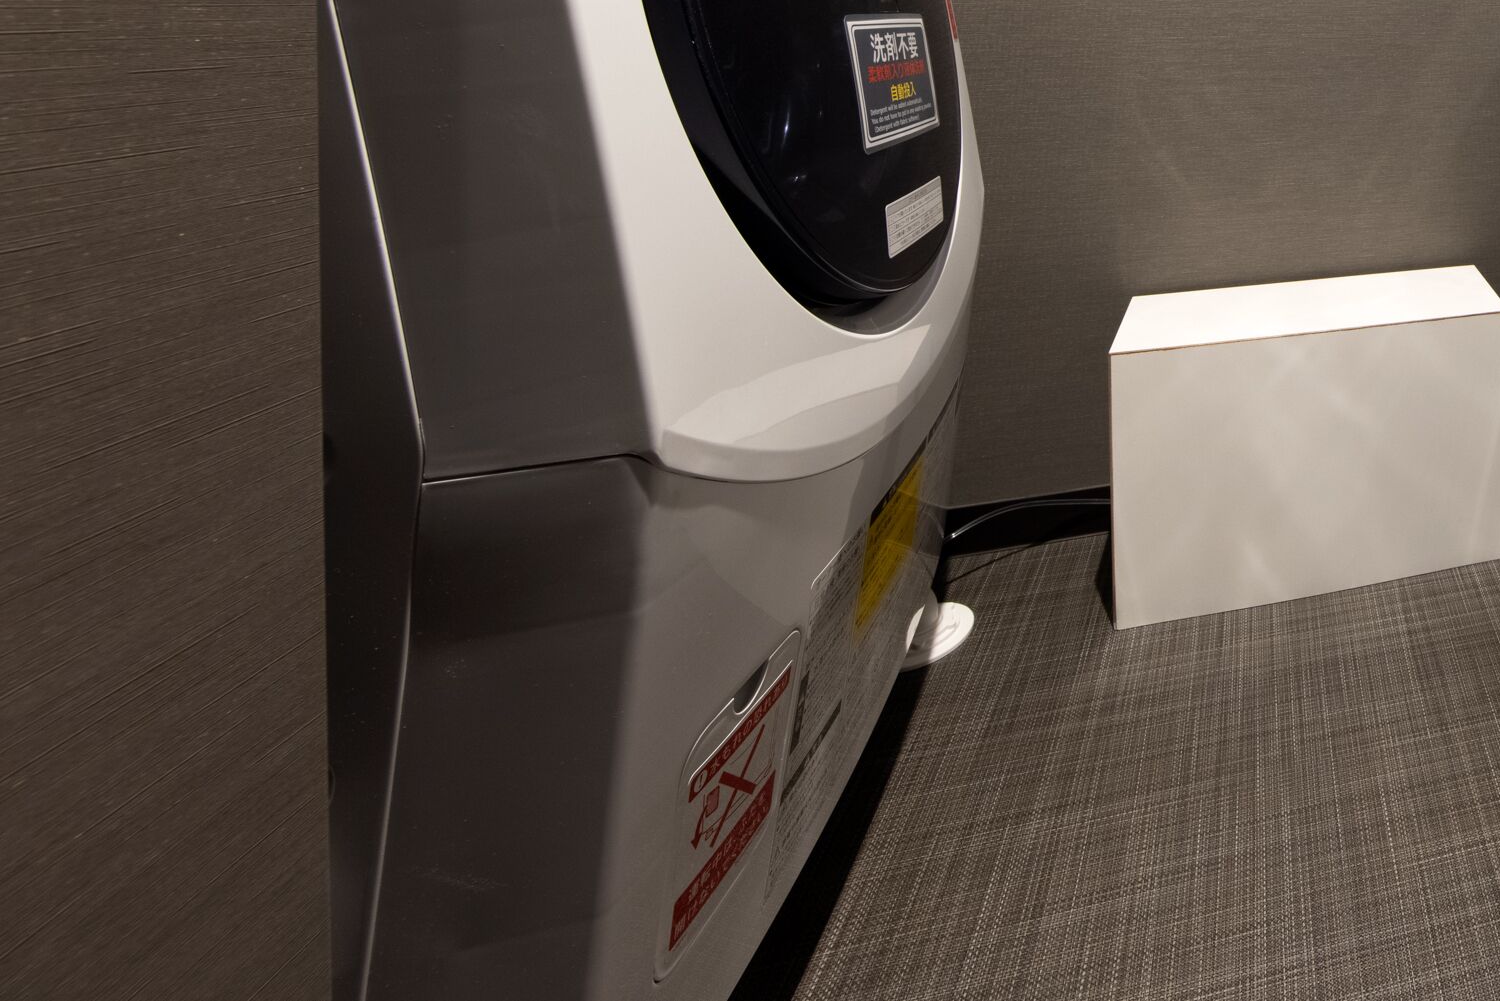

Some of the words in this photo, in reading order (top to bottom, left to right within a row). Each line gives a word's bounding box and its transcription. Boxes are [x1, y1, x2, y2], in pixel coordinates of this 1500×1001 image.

[868, 31, 919, 63] 洗剤不要
[889, 80, 916, 102] 自動投入
